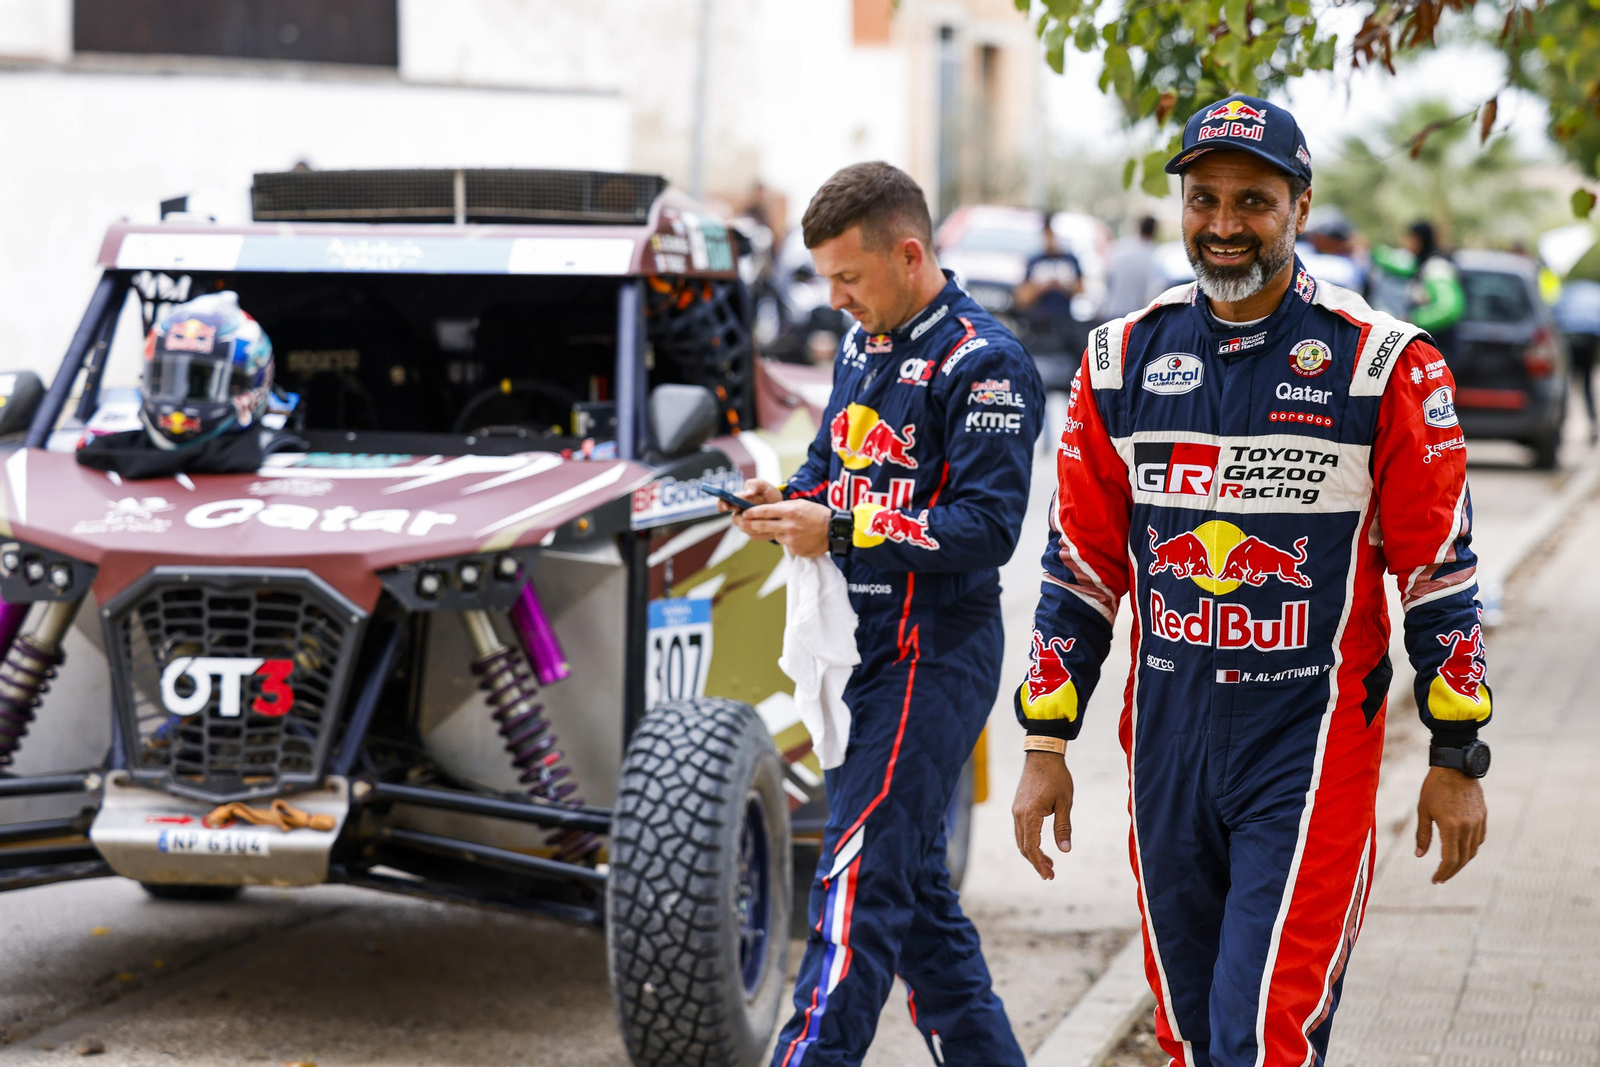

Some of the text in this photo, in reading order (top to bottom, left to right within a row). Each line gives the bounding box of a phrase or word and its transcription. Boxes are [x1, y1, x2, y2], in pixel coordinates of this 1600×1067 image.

[1198, 121, 1265, 142] Red Bull
[941, 337, 989, 376] sparco
[1097, 327, 1110, 370] sparco
[1219, 343, 1240, 353] GR
[1367, 331, 1402, 379] sparco
[900, 357, 936, 381] OT3
[1147, 367, 1199, 382] eurol
[967, 390, 1026, 408] MOBILE
[1275, 382, 1332, 405] Qatar
[965, 412, 1021, 429] KMC
[1270, 412, 1332, 426] ooredoo
[1429, 402, 1456, 419] euro
[1433, 435, 1465, 452] REBELLI
[1230, 446, 1339, 467] TOYOTA
[1137, 463, 1214, 496] GR
[1223, 465, 1326, 483] GAZOO
[1219, 483, 1320, 504] Racing
[184, 499, 458, 536] Qatar
[1150, 588, 1310, 651] Red Bull
[1146, 654, 1175, 671] sparco
[1255, 666, 1319, 682] AL-ATTIYAH
[160, 656, 295, 717] OT3
